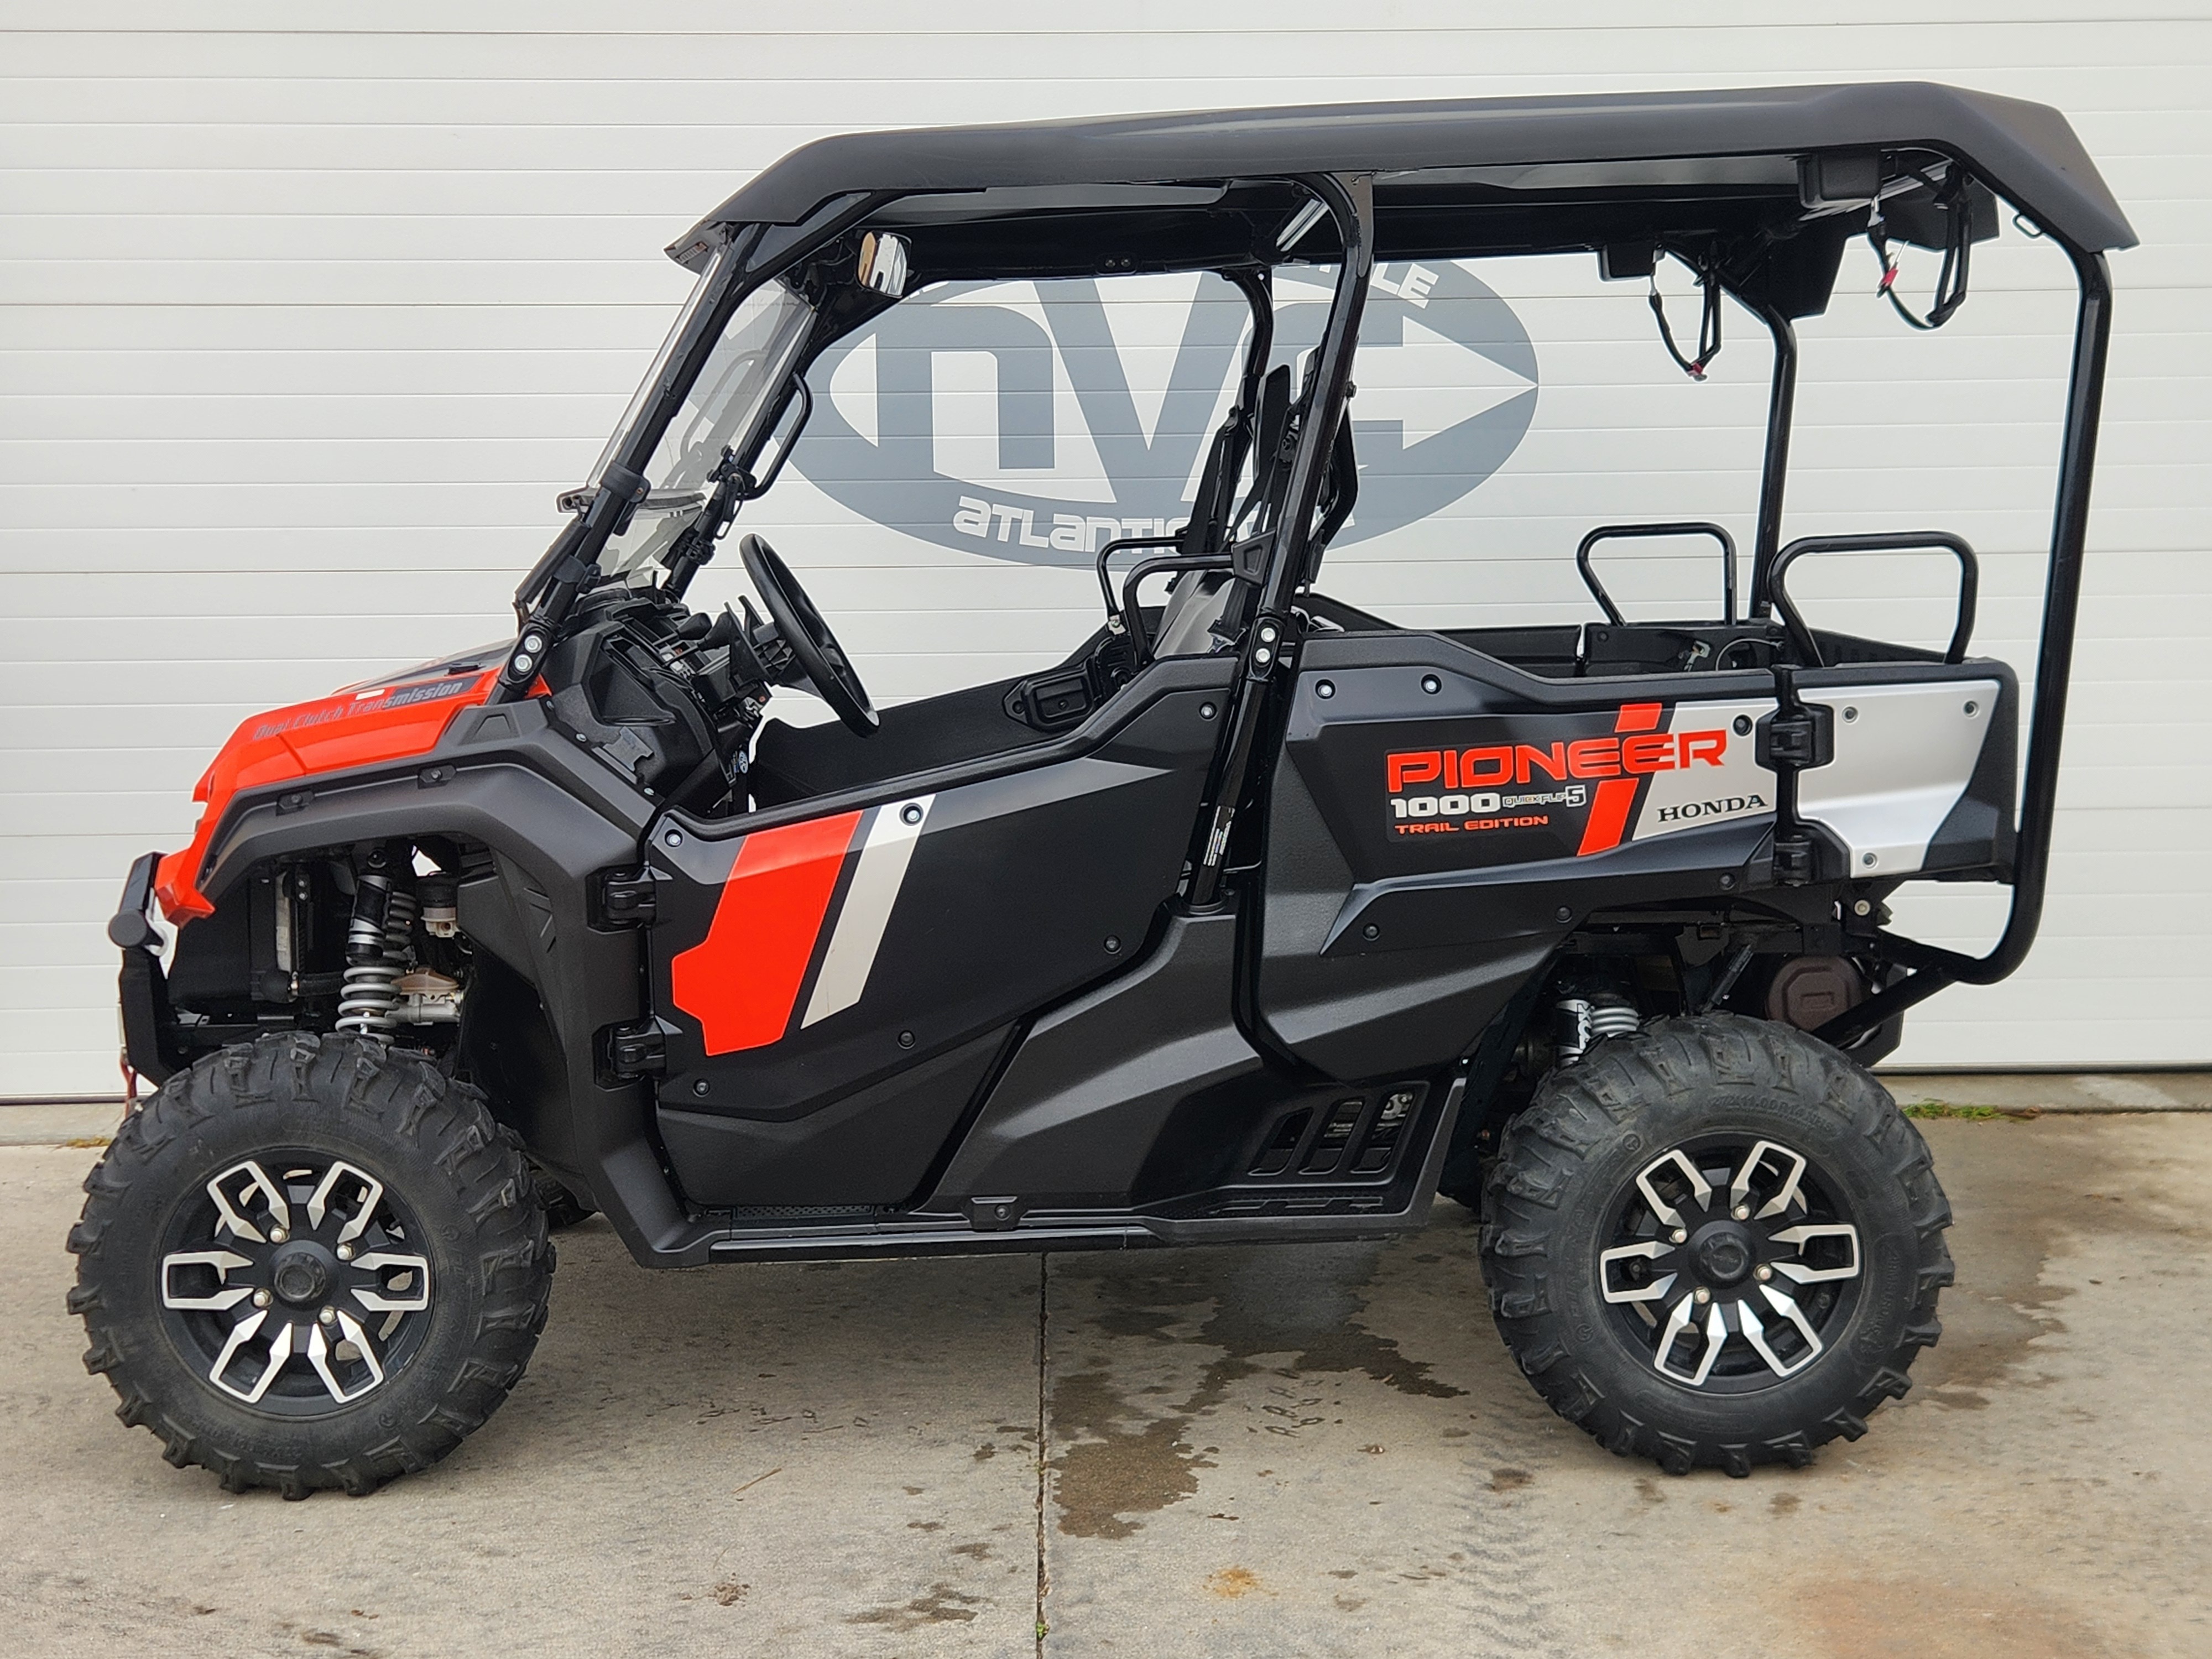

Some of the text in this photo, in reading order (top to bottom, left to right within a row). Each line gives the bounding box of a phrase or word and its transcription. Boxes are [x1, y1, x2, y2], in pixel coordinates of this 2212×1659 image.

[292, 705, 344, 729] Clutch
[347, 682, 463, 717] Transmission
[1386, 729, 1727, 793] PIONEER
[1390, 792, 1501, 818] 1000
[1657, 794, 1768, 823] HONDA
[1395, 815, 1548, 834] TRAIL EDITION
